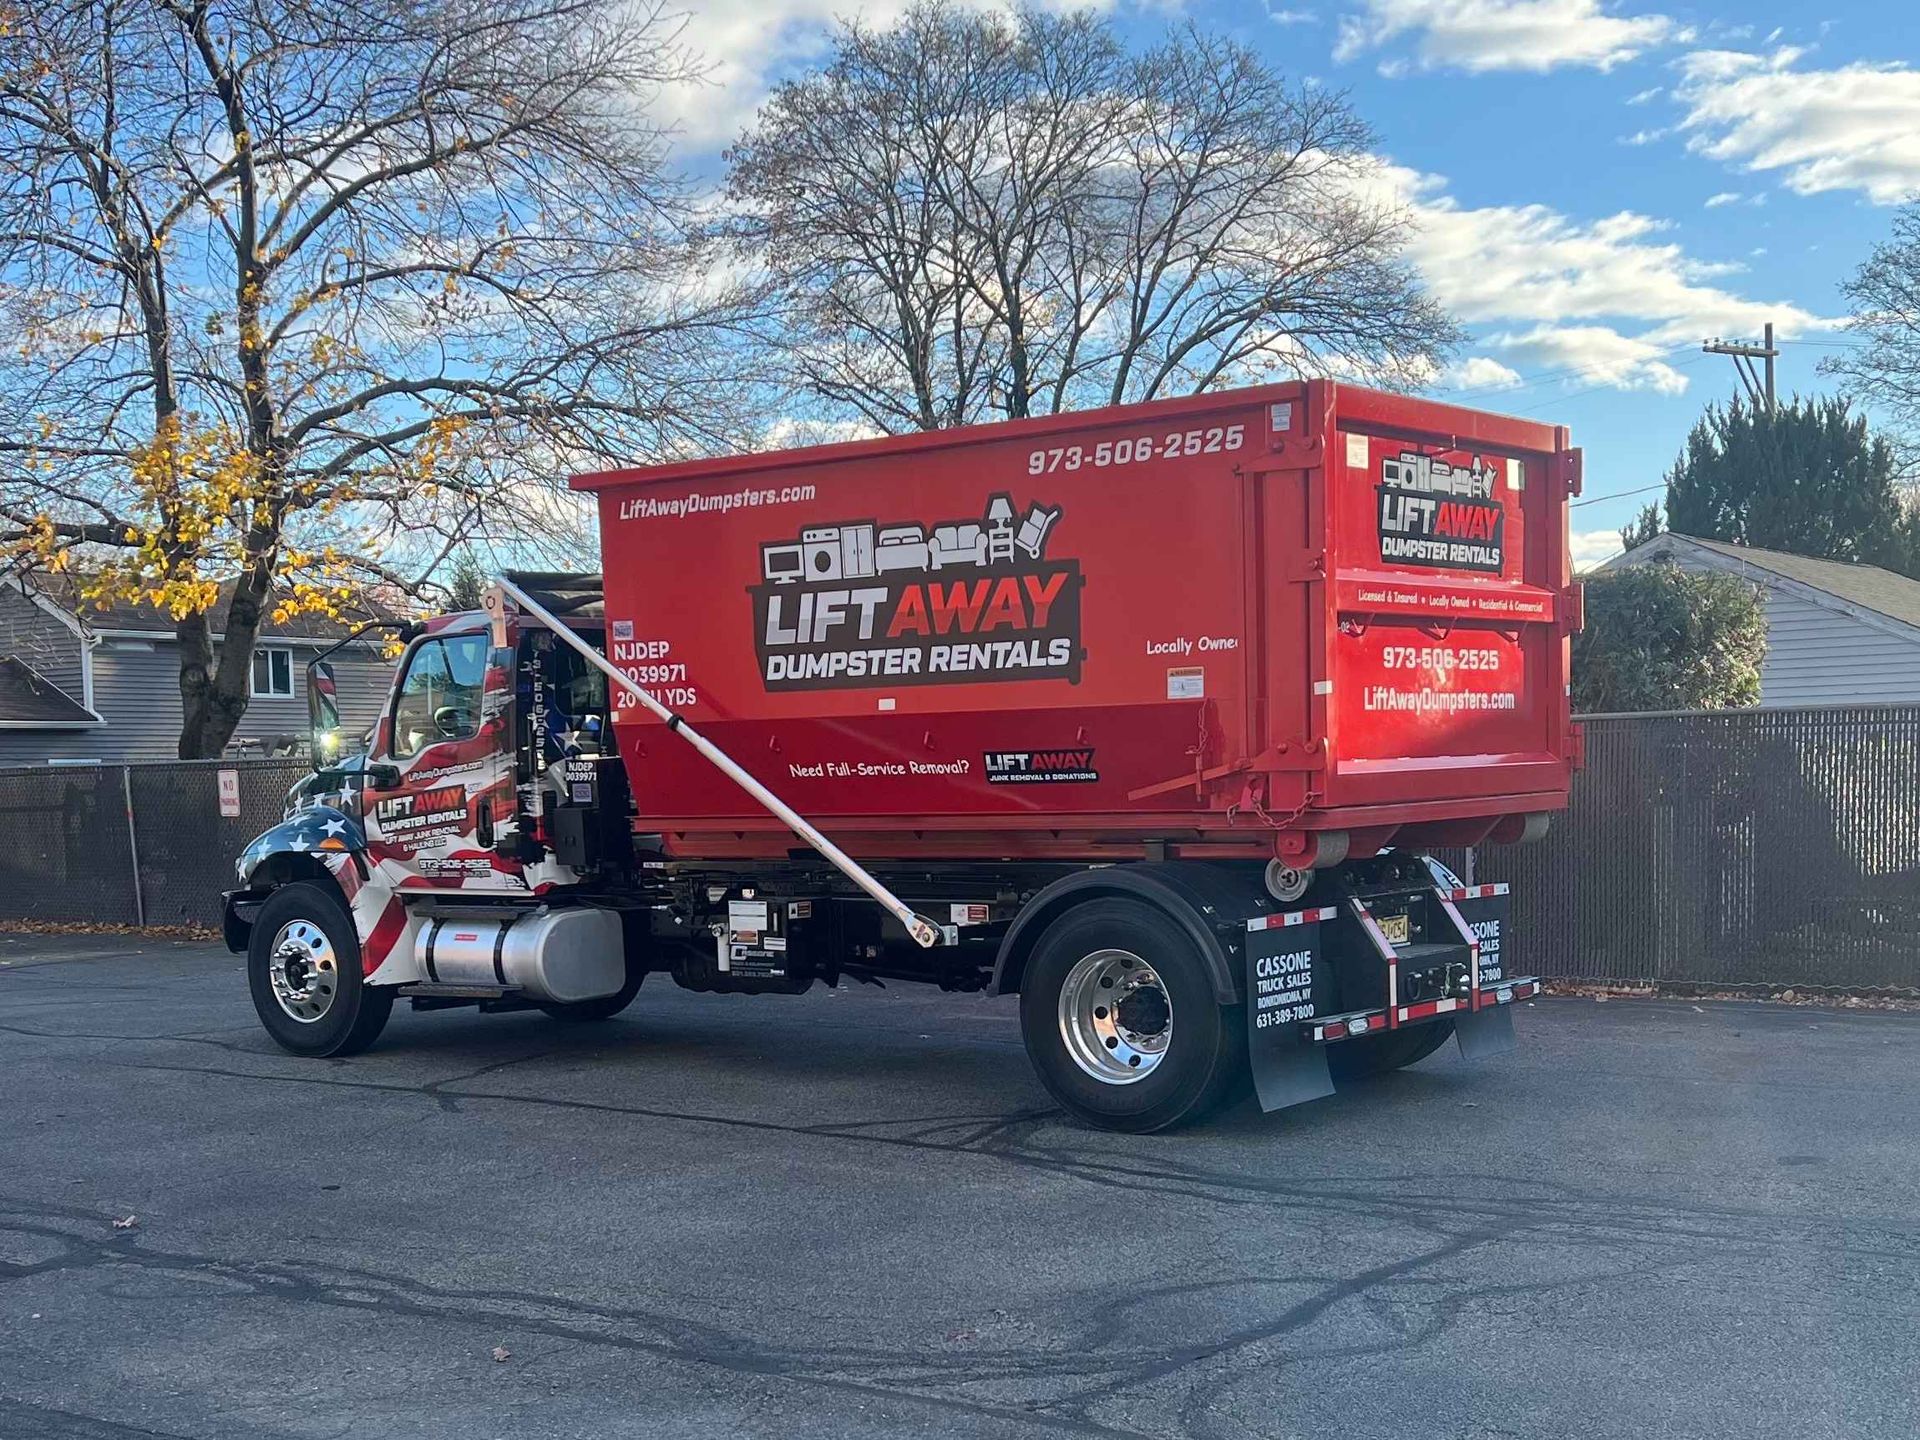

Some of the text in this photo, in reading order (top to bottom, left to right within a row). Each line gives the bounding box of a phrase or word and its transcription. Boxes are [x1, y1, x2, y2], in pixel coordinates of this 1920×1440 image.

[1028, 424, 1245, 475] 973-506-2525
[619, 484, 816, 520] LiftAwayDumpsters.com
[1381, 494, 1499, 541] LIFT AWAY
[1382, 536, 1500, 566] DUMPSTER RENTALS
[1358, 589, 1386, 602] Licensed
[1393, 591, 1418, 604] Insured
[1429, 594, 1470, 610] Locally Owned
[765, 572, 1069, 646] LIFT AWAY
[613, 640, 670, 661] NJDEP
[1146, 636, 1238, 656] Locally Owne
[766, 637, 1071, 681] DUMPSTER RENTALS
[1383, 646, 1499, 670] 973-506-2525
[617, 690, 637, 708] 20
[665, 687, 697, 706] YDS
[1364, 686, 1515, 715] LiftAwayDumpsters.com
[568, 762, 594, 772] NJDEP
[789, 760, 970, 778] Need Full-Service Removal?
[985, 752, 1089, 771] LIFT AWAY
[223, 779, 234, 791] NO
[566, 772, 597, 781] 0039971
[1010, 774, 1044, 782] REMOVAL
[1052, 772, 1097, 780] DONATIONS
[378, 796, 413, 819] LIFT
[413, 788, 463, 813] AWAY
[381, 809, 467, 832] DUMPSTER RENTALS
[1479, 939, 1500, 953] SALES
[1256, 950, 1312, 978] CASSONE
[1257, 972, 1312, 994] TRUCK SALES
[1256, 1003, 1315, 1029] 631-389-7800
